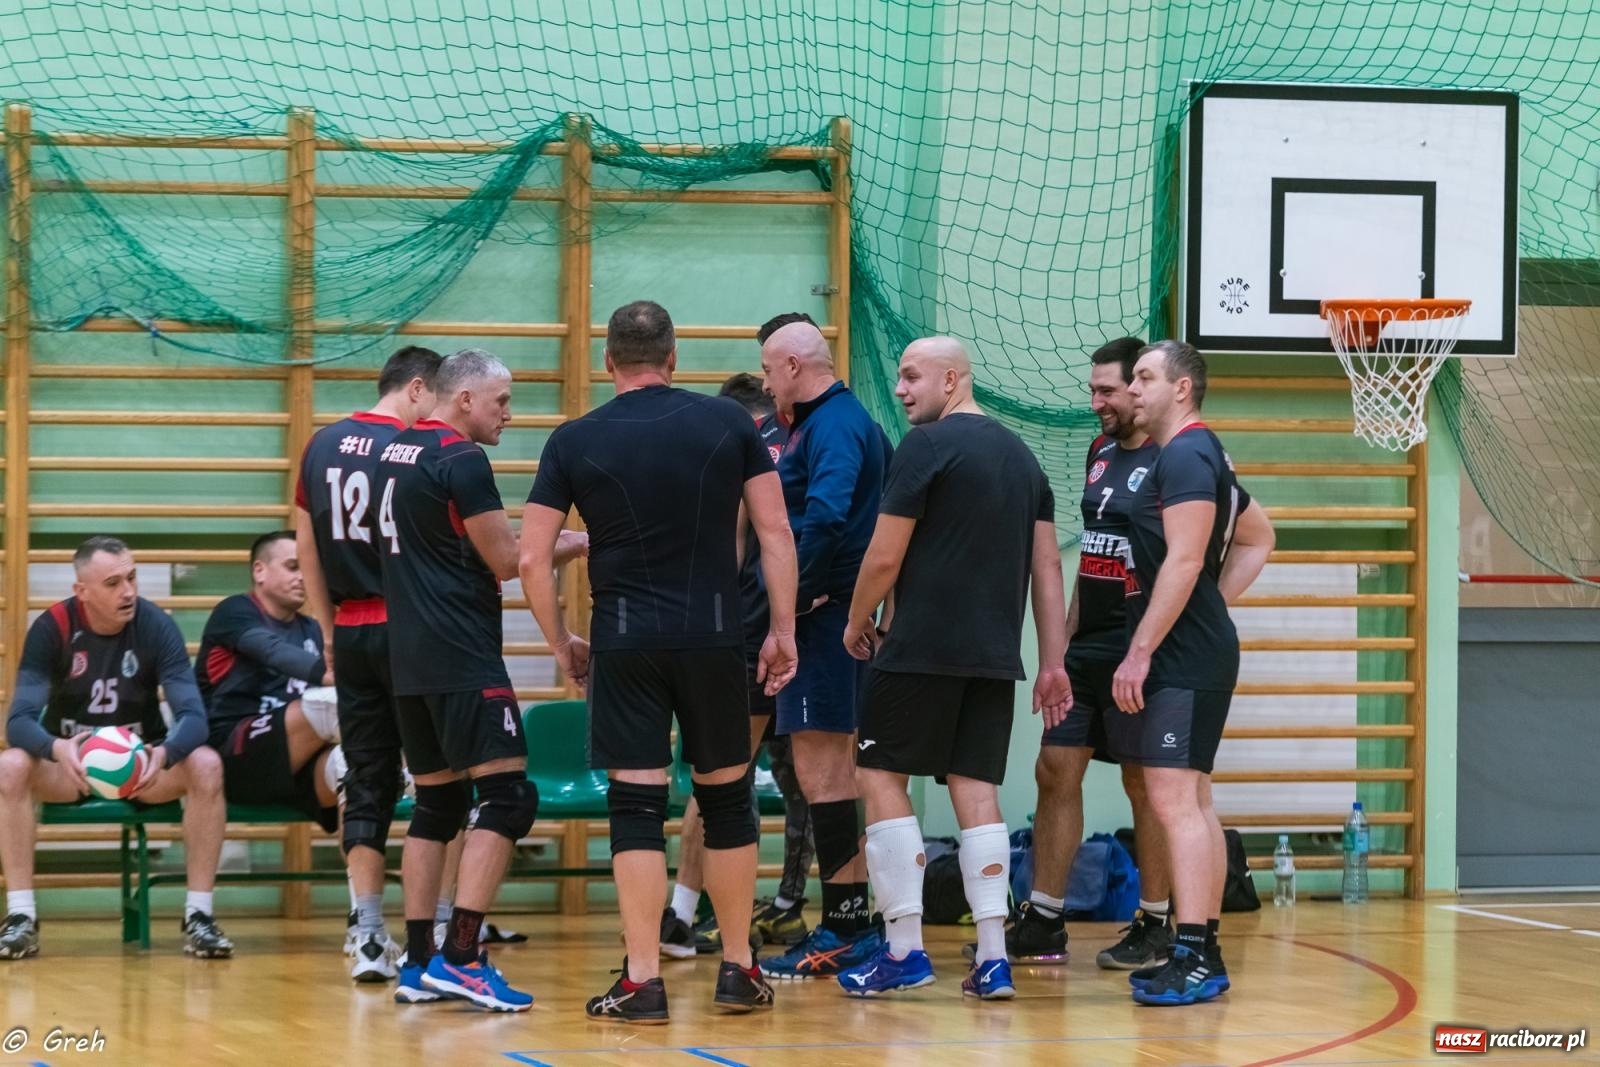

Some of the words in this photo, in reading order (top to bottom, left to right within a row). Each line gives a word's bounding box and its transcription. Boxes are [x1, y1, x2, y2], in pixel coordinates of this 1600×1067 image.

[1220, 277, 1250, 291] SURE
[1219, 300, 1249, 314] SHOT
[327, 467, 371, 543] 12
[379, 478, 400, 553] 4
[1097, 487, 1114, 519] 7
[87, 677, 118, 714] 25
[503, 706, 517, 737] 4
